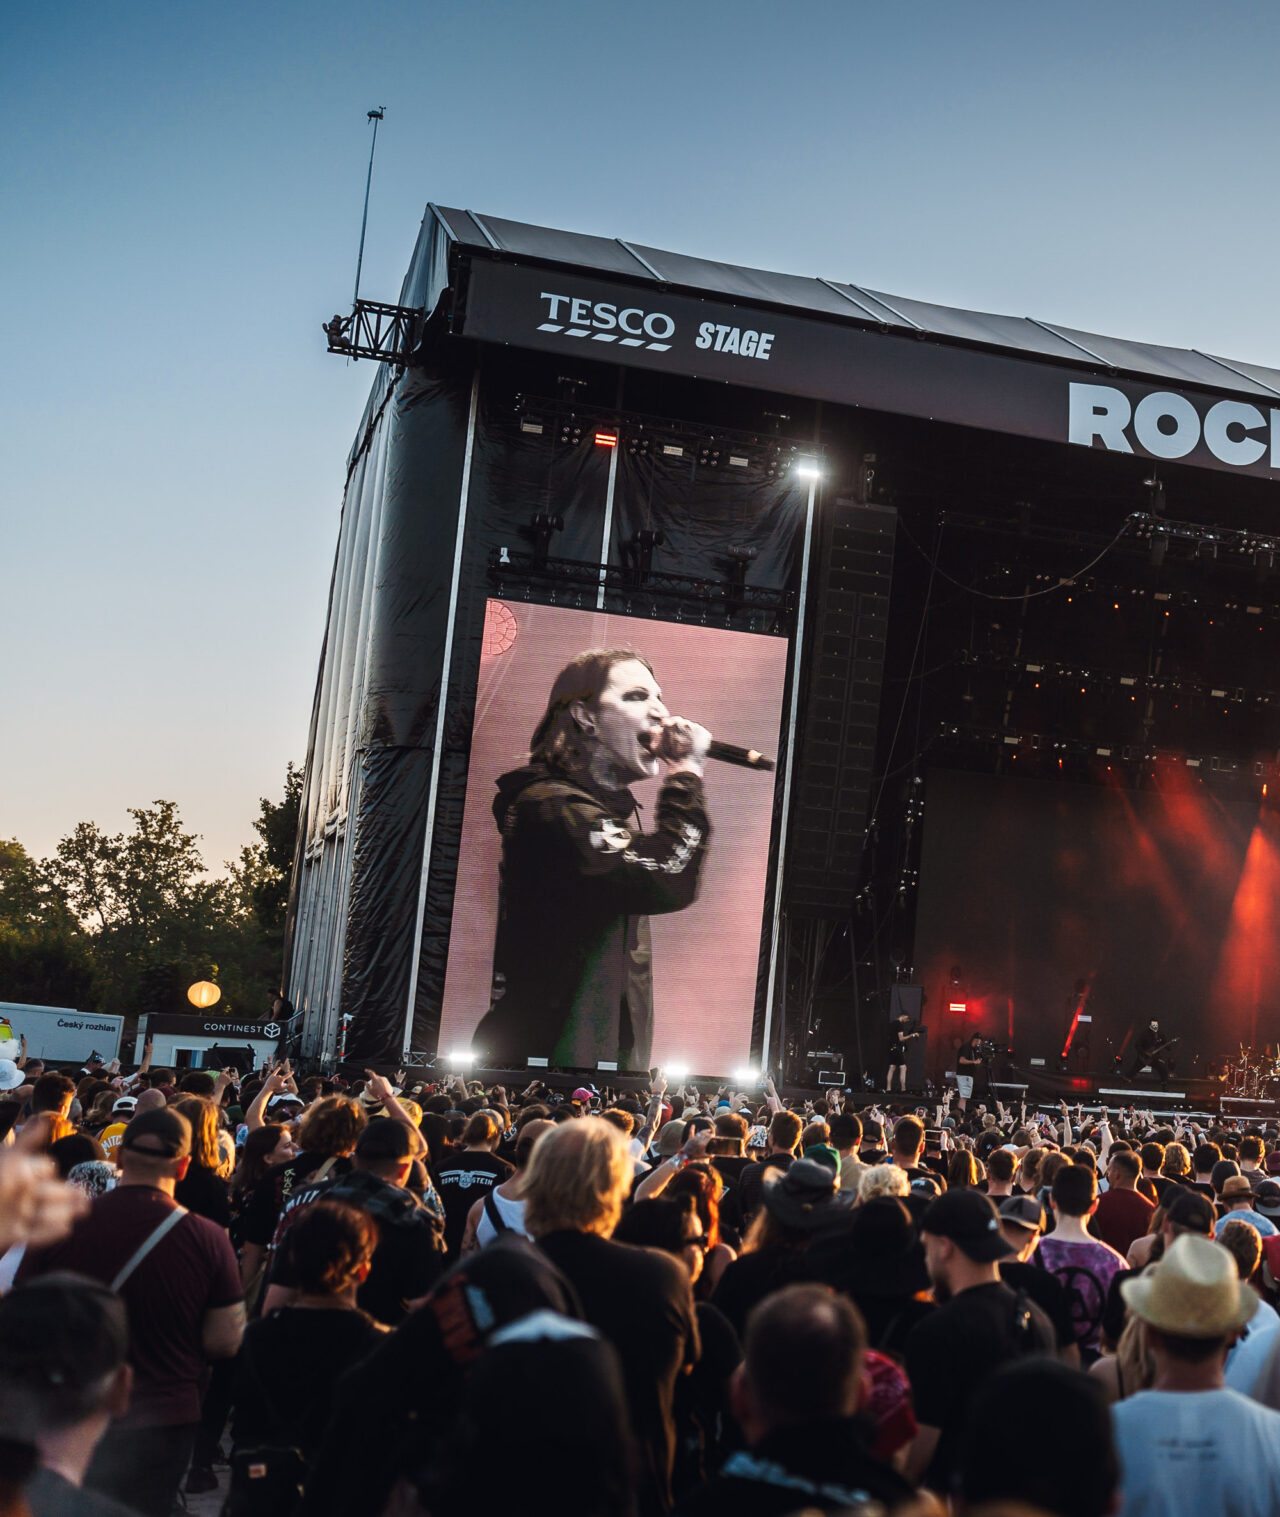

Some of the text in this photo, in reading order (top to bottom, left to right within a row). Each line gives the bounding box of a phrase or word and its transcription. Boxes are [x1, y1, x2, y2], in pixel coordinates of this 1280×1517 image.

[540, 292, 775, 360] TESCO STAGE
[57, 1018, 116, 1033] Český rozhlas
[203, 1022, 262, 1033] CONTINEST
